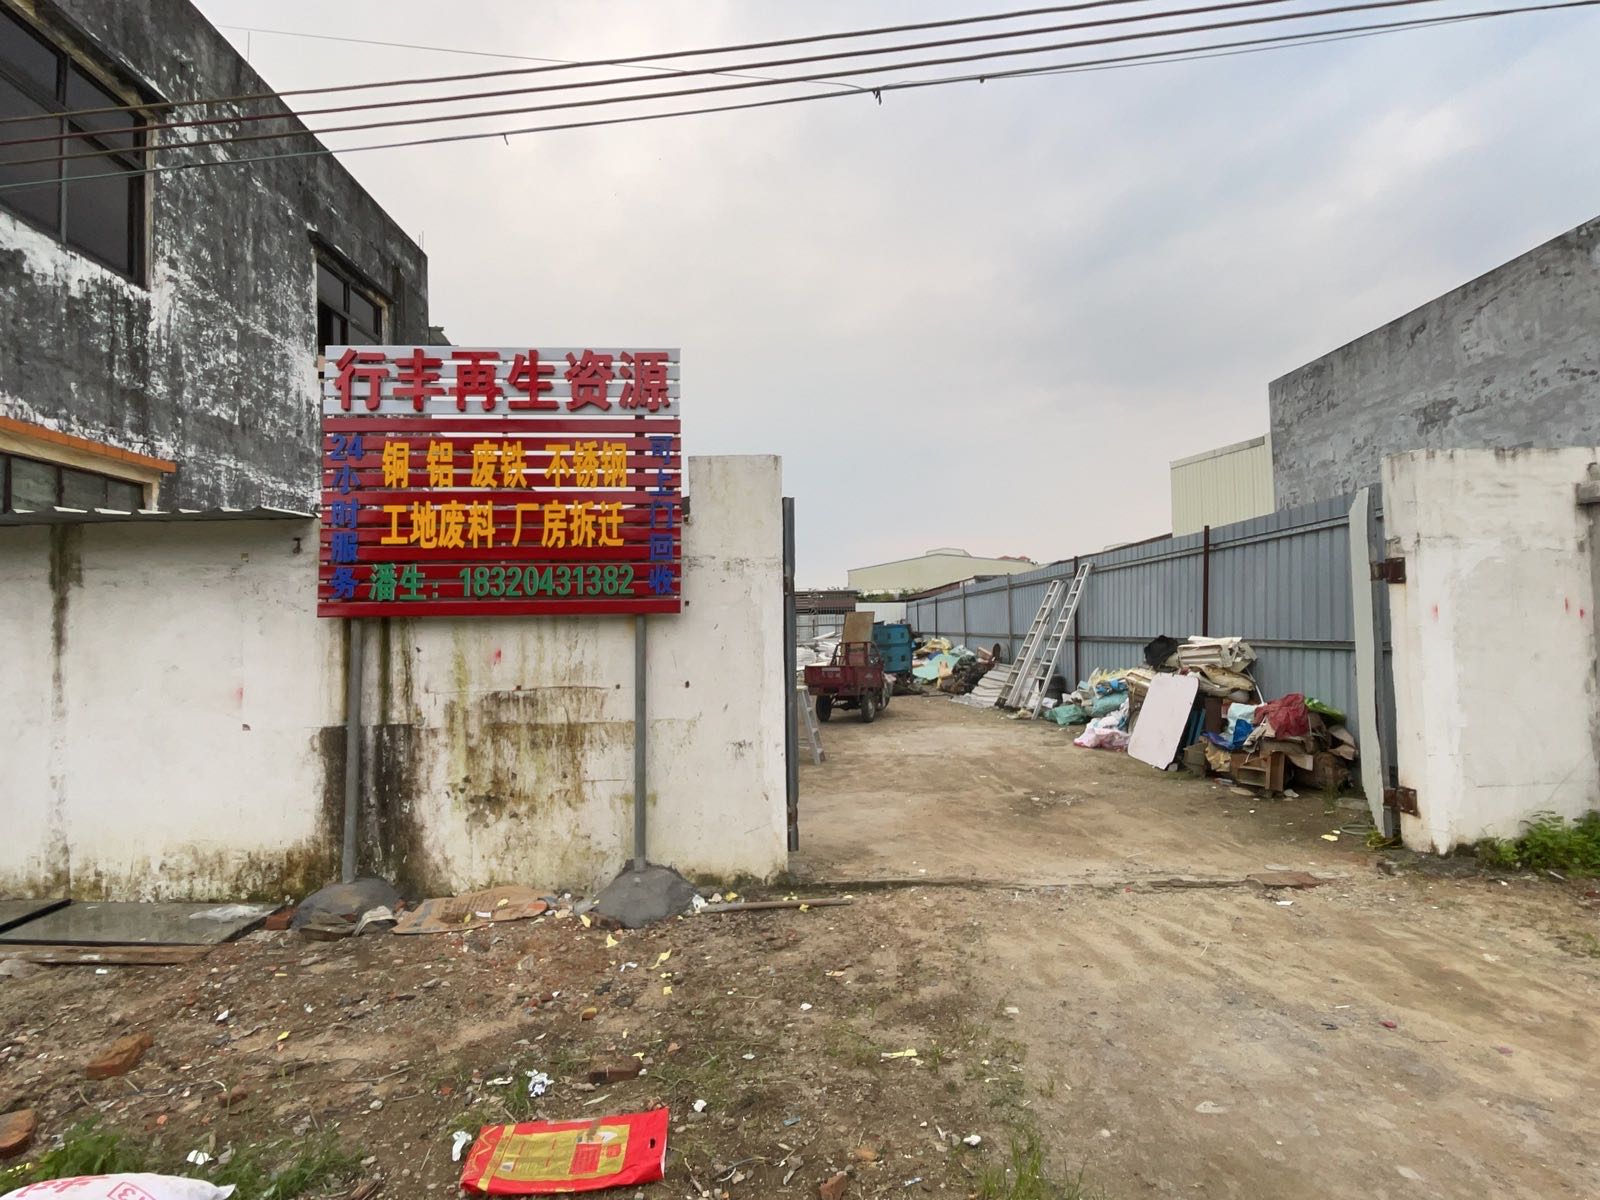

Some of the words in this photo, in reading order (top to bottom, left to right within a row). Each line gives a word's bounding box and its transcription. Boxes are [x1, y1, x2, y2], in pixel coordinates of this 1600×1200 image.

[334, 347, 673, 412] 行丰再生资源
[381, 440, 410, 488] 铜
[426, 440, 454, 488] 铝
[470, 440, 527, 488] 废铁
[544, 442, 627, 488] 不锈钢
[331, 434, 364, 600] 24小时服务
[380, 500, 496, 549] 工地废料
[511, 500, 624, 549] 厂房拆迁
[649, 436, 674, 596] 可上门回收
[459, 565, 635, 598] 18320431382
